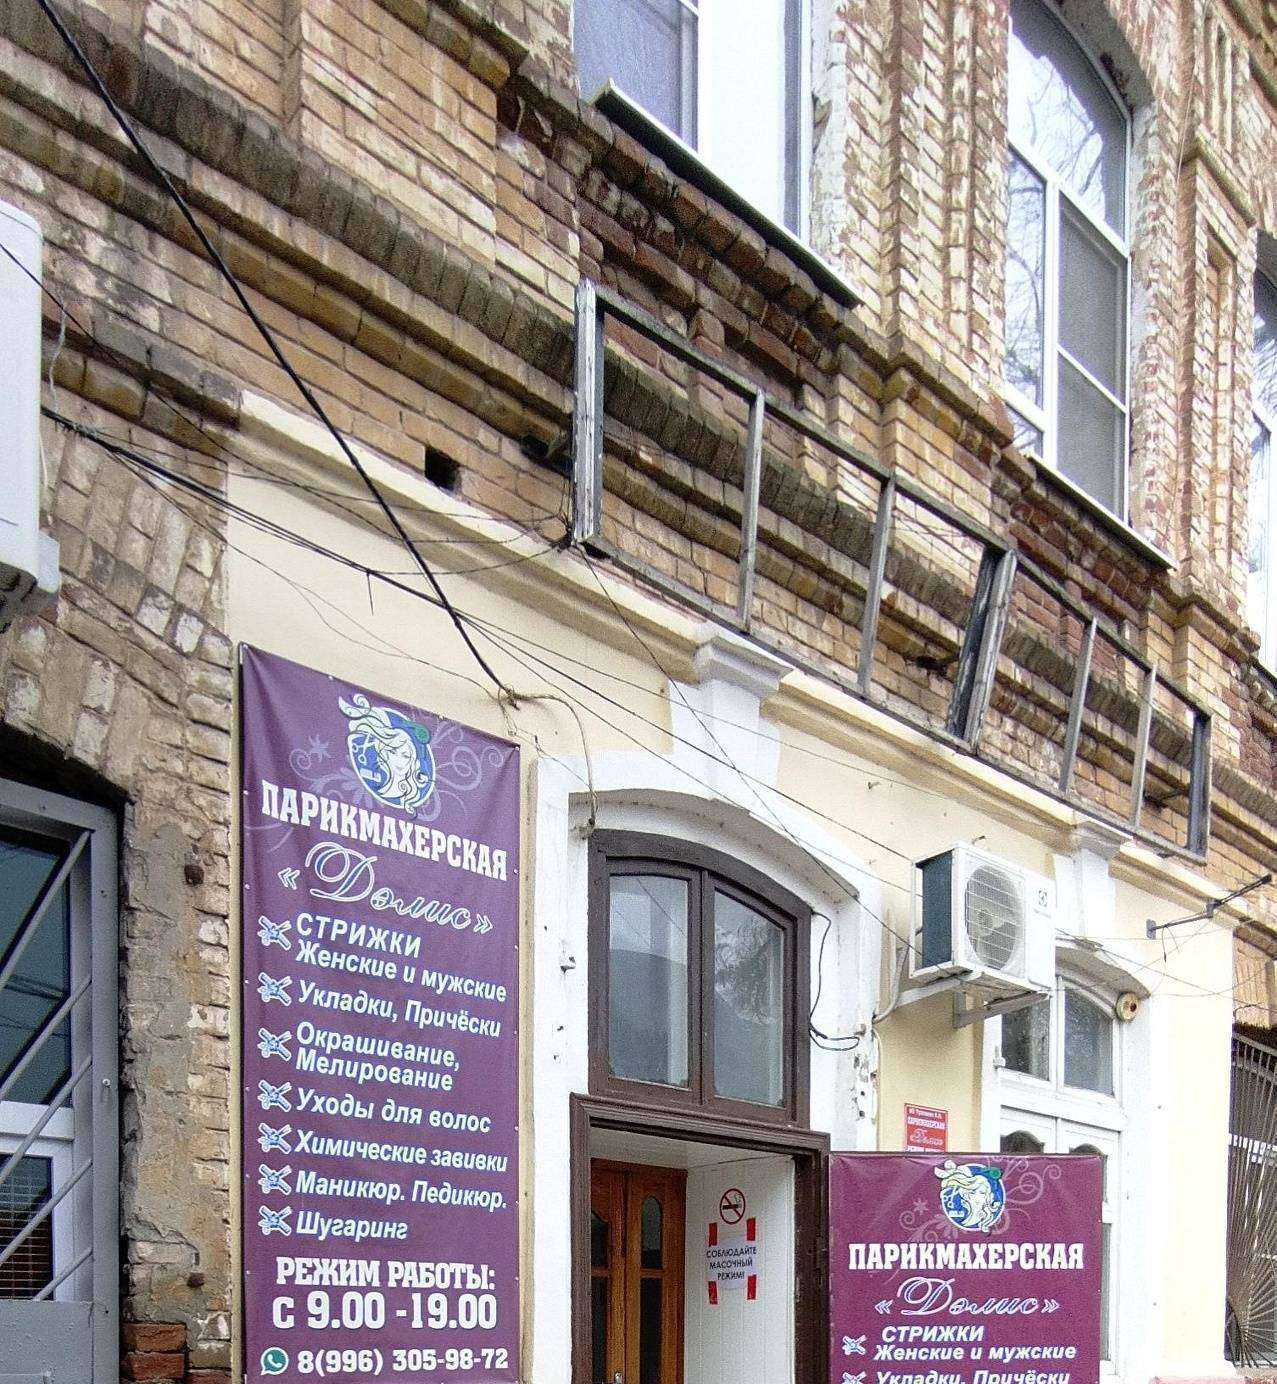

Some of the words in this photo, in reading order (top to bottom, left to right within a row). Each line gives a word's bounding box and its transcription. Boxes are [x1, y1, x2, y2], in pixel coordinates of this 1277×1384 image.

[261, 779, 508, 881] ПАРИКМАХЕРСКАЯ
[296, 912, 421, 959] СТРИЖКИ
[296, 938, 397, 980] Женские
[403, 963, 415, 984] и
[421, 969, 507, 1002] мужские
[298, 979, 398, 1023] Укладки,
[404, 999, 501, 1038] Причёски
[296, 1021, 460, 1072] Окрашивание,
[295, 1047, 453, 1092] Мелирование
[296, 1087, 374, 1120] Уходы
[381, 1098, 422, 1125] для
[429, 1109, 491, 1133] волос
[295, 1129, 427, 1165] Химические
[430, 1149, 508, 1172] завивки
[295, 1170, 405, 1205] Маникюр.
[411, 1180, 507, 1213] Педикюр.
[295, 1210, 408, 1243] Шугаринг
[706, 1245, 757, 1259] СОБЛЮДАЙТЕ
[709, 1257, 753, 1270] МАСОЧНЫЙ
[848, 1243, 1084, 1270] ПАРИКМАХЕРСКАЯ
[276, 1256, 380, 1287] РЕЖИМ
[387, 1260, 496, 1290] РАБОТЫ:
[306, 1290, 385, 1329] 9.00
[873, 1344, 964, 1361] Женские
[970, 1349, 982, 1360] и
[988, 1346, 1077, 1363] мужские
[881, 1325, 985, 1342] СТРИЖКИ
[297, 1349, 384, 1376] 8(996)
[392, 1348, 509, 1371] 305-98-72
